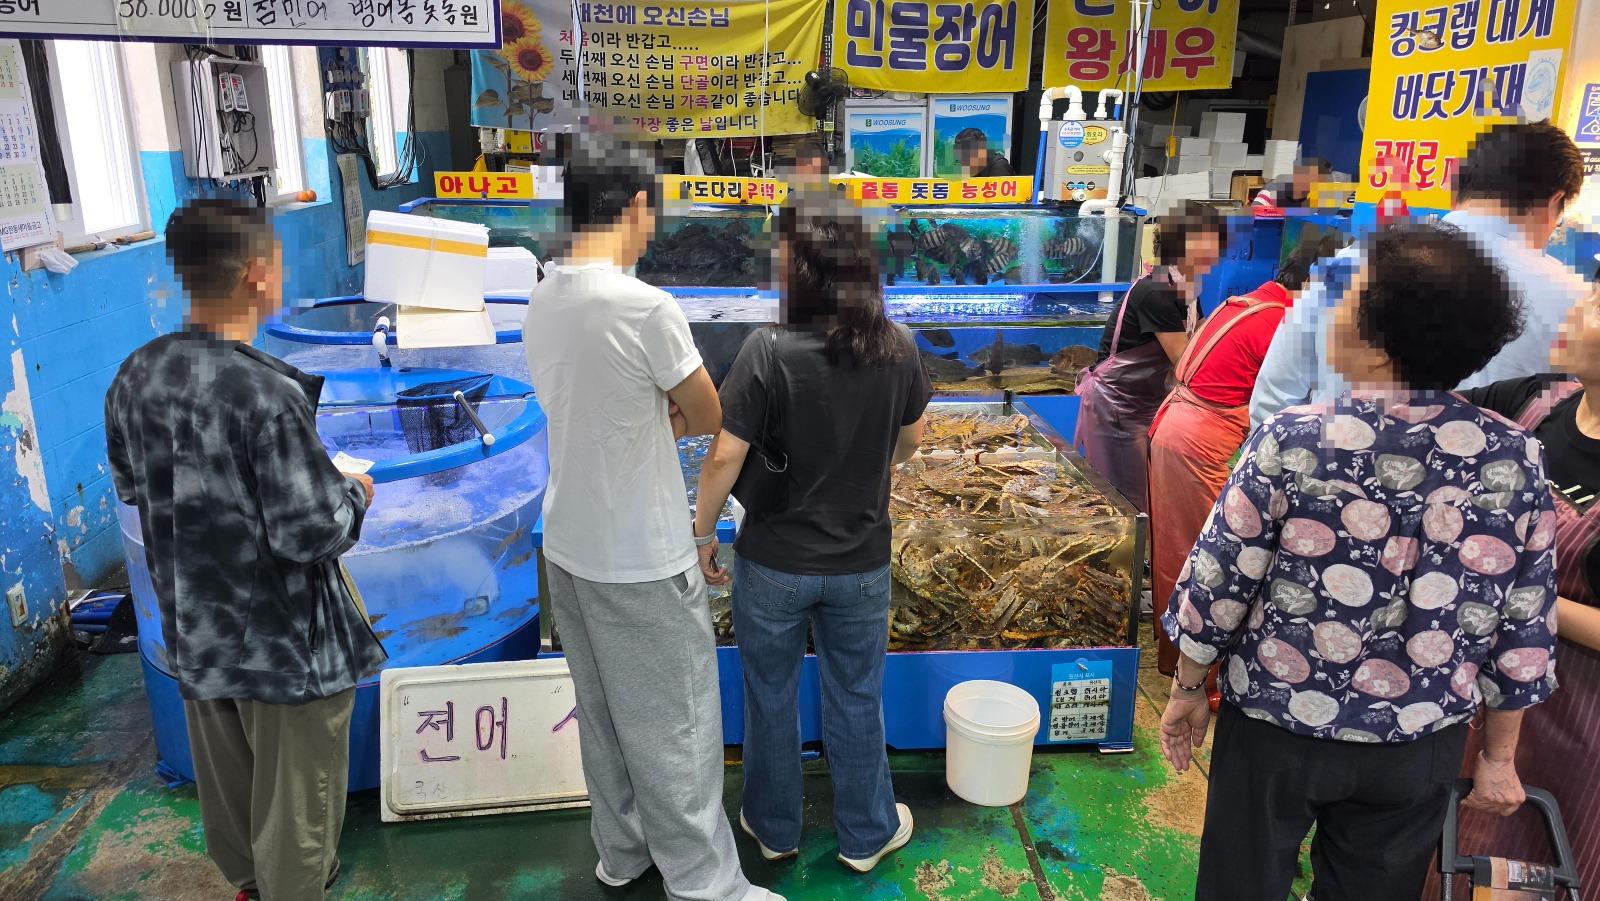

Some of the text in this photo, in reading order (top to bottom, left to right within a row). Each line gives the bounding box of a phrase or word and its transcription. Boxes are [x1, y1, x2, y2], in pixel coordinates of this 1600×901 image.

[846, 0, 1017, 71] 민물장어
[1390, 0, 1555, 57] 킹크랩 대게
[610, 53, 640, 69] 오신
[645, 54, 674, 70] 손님
[680, 55, 740, 71] 구면이라
[1066, 27, 1215, 80] 왕새우
[611, 73, 640, 89] 오신
[645, 74, 674, 90] 손님
[680, 74, 739, 90] 단골이라
[611, 93, 641, 109] 오신
[645, 94, 674, 110] 손님
[681, 94, 738, 110] 가족같이
[744, 89, 800, 108] 좋습니다
[633, 117, 661, 133] 가장
[666, 117, 694, 132] 좋은
[700, 115, 758, 132] 날입니다
[439, 175, 518, 194] 아나고
[961, 180, 1017, 199] 능성어
